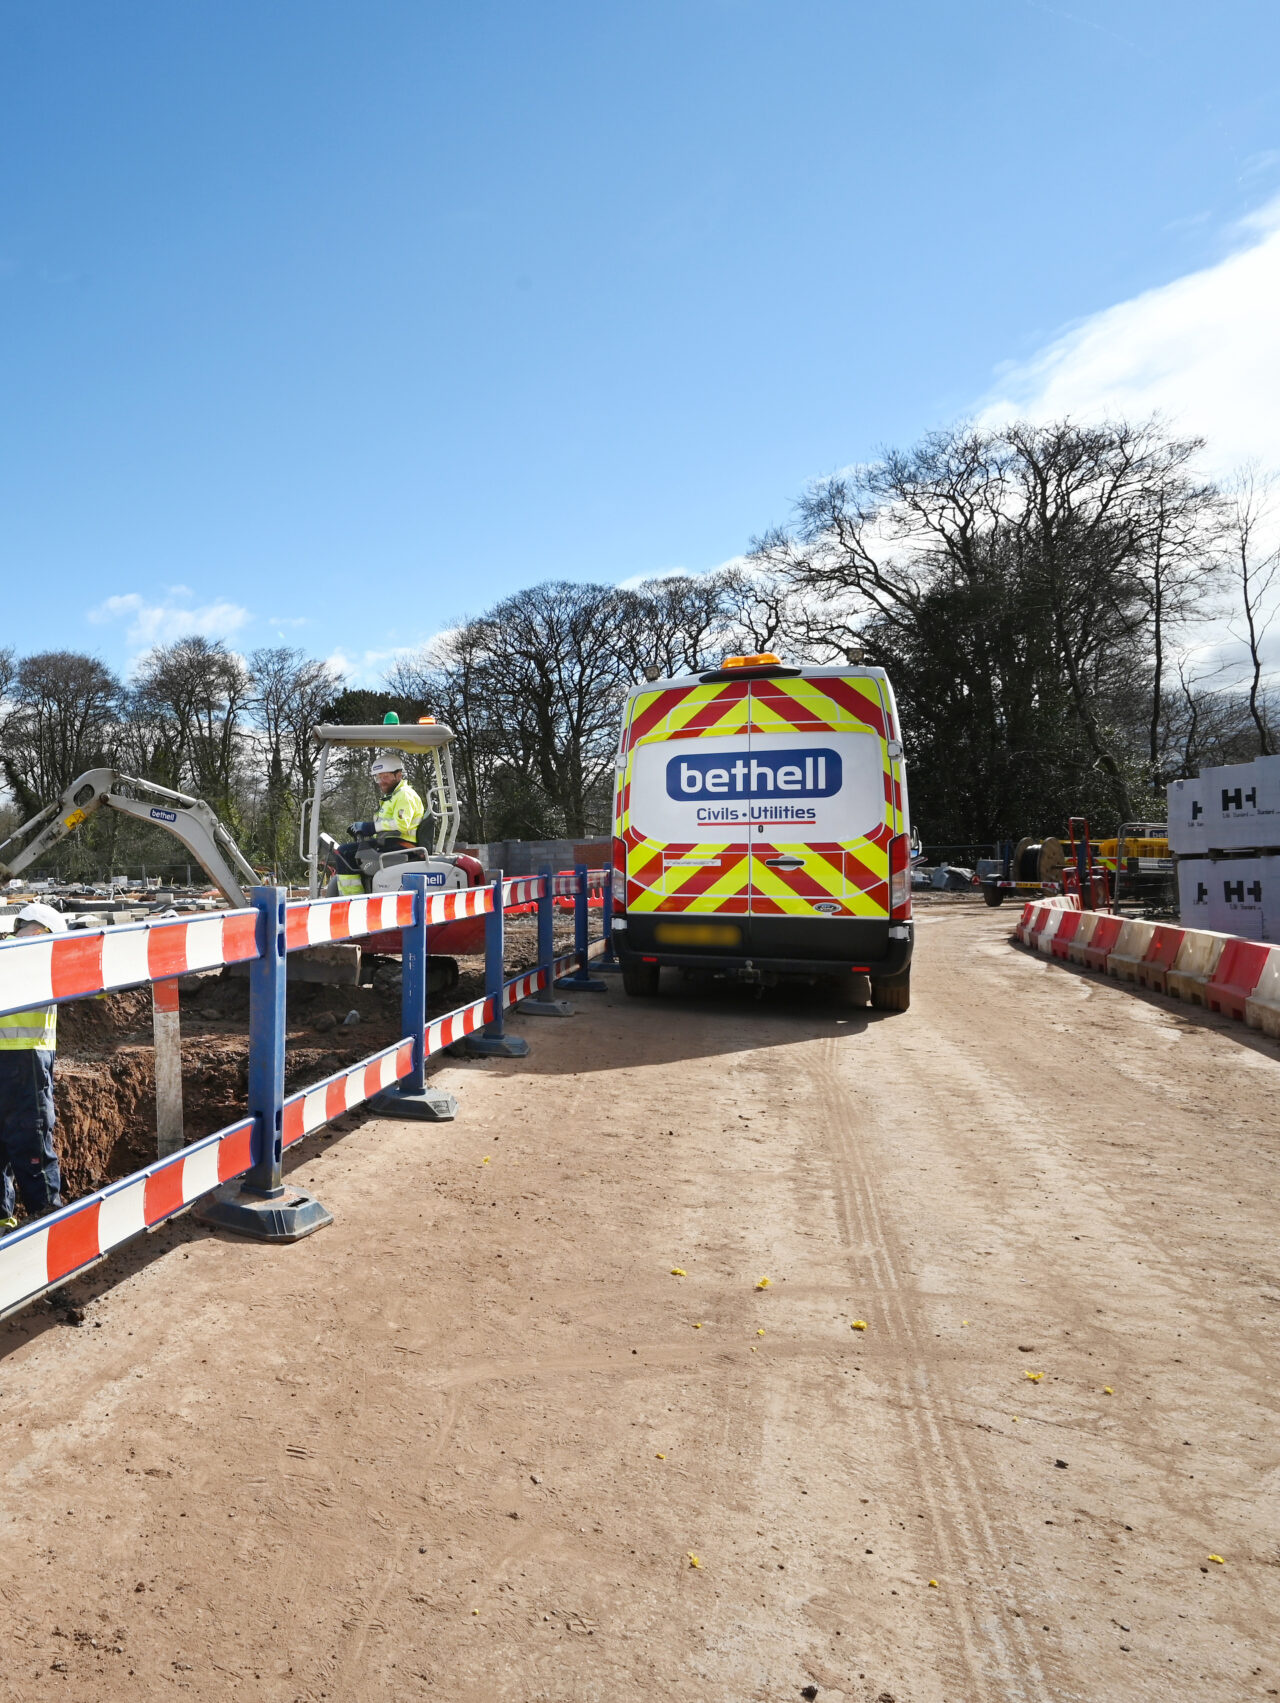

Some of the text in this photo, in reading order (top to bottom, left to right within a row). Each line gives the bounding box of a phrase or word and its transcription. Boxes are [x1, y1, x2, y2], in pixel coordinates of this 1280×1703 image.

[680, 756, 826, 794] bethell
[151, 809, 175, 821] bethell
[697, 805, 816, 821] Civils Utilities
